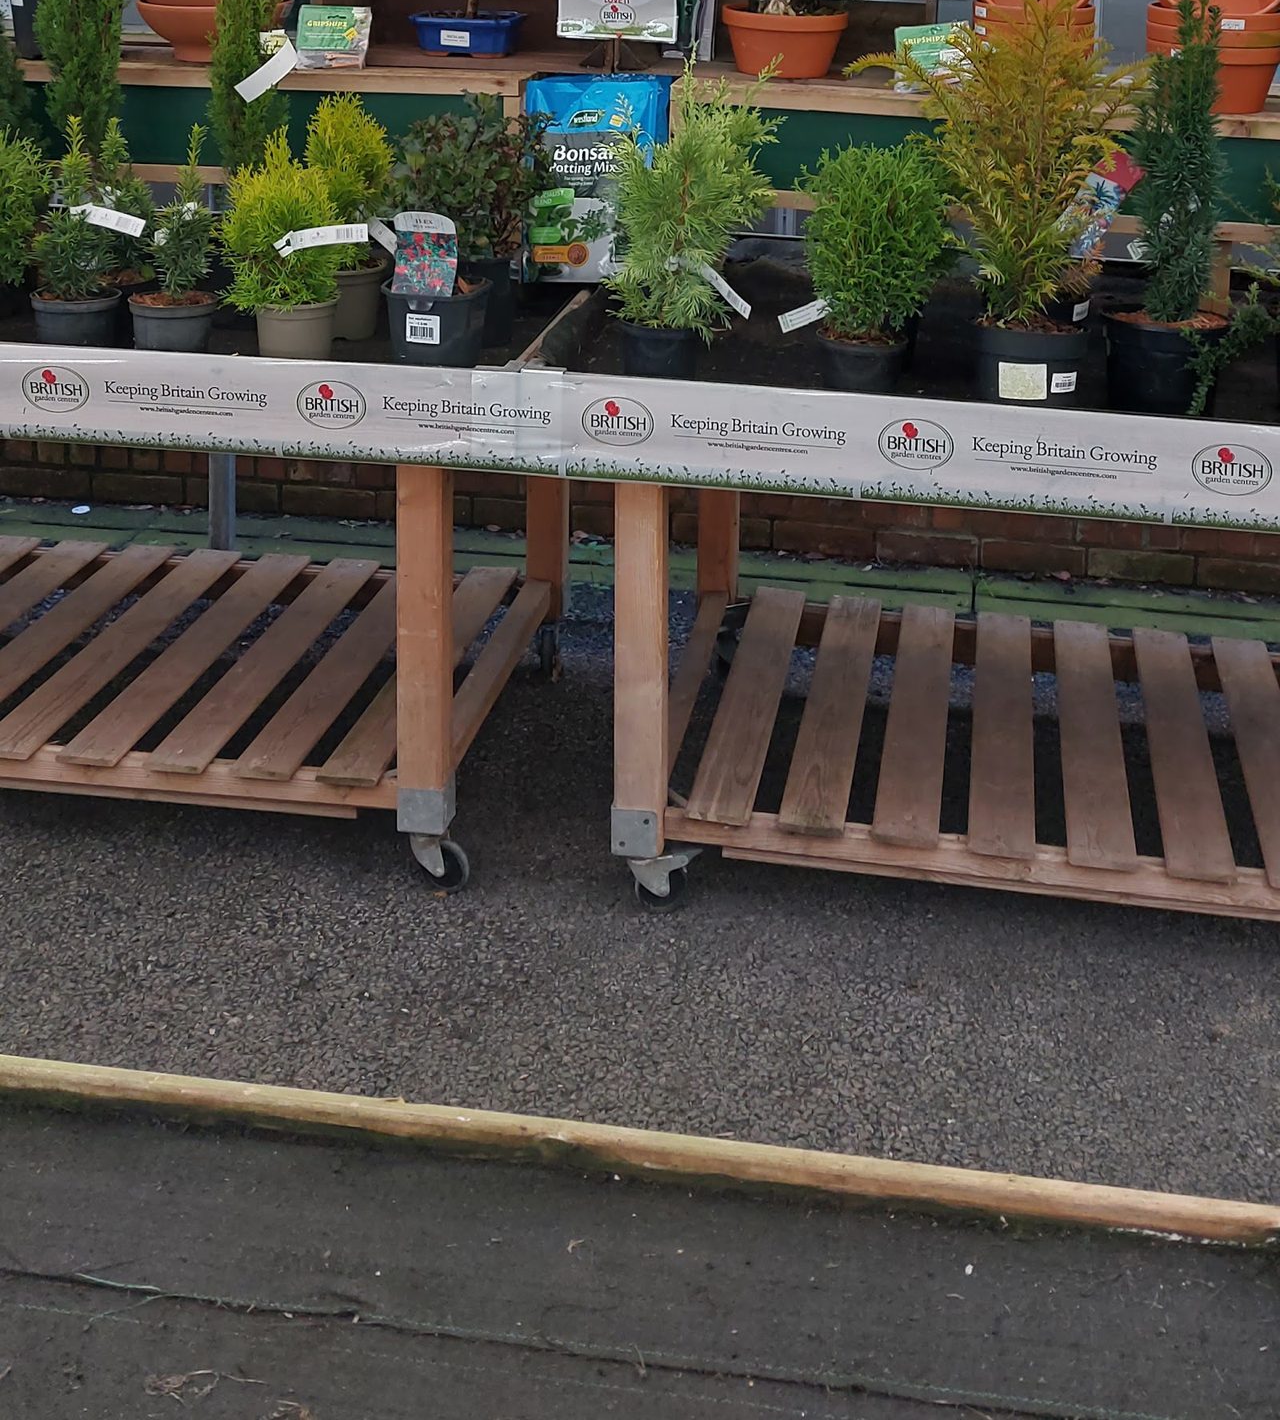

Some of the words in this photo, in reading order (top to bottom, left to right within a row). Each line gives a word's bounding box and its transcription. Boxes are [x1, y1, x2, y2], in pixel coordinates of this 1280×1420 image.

[603, 11, 632, 21] BRITISH
[573, 113, 598, 124] westland
[553, 142, 616, 162] Bonsai
[549, 162, 592, 176] Potting
[594, 161, 616, 173] Mix
[30, 382, 83, 397] BRITISH
[104, 380, 158, 400] Keeping
[161, 384, 204, 399] Britain
[208, 386, 268, 407] Growing
[34, 394, 56, 403] garden
[57, 396, 80, 404] centres
[305, 397, 359, 414] BRITISH
[308, 411, 331, 420] garden
[332, 412, 356, 420] centres
[382, 396, 438, 416] Keeping
[441, 400, 486, 416] Britain
[489, 404, 552, 424] Growing
[590, 414, 646, 432] BRITISH
[670, 414, 728, 436] Keeping
[731, 418, 778, 436] Britain
[782, 422, 846, 445] Growing
[594, 429, 618, 438] garden
[618, 430, 642, 438] centres
[888, 436, 946, 454] BRITISH
[890, 450, 916, 460] garden
[916, 453, 942, 461] centres
[972, 436, 1033, 460] Keeping
[1036, 441, 1086, 460] Britain
[1090, 446, 1158, 470] Growing
[1010, 465, 1118, 480] www.britishgardencentres.com
[1201, 460, 1264, 479] BRITISH
[1205, 476, 1231, 484] garden
[1232, 478, 1259, 486] centres
